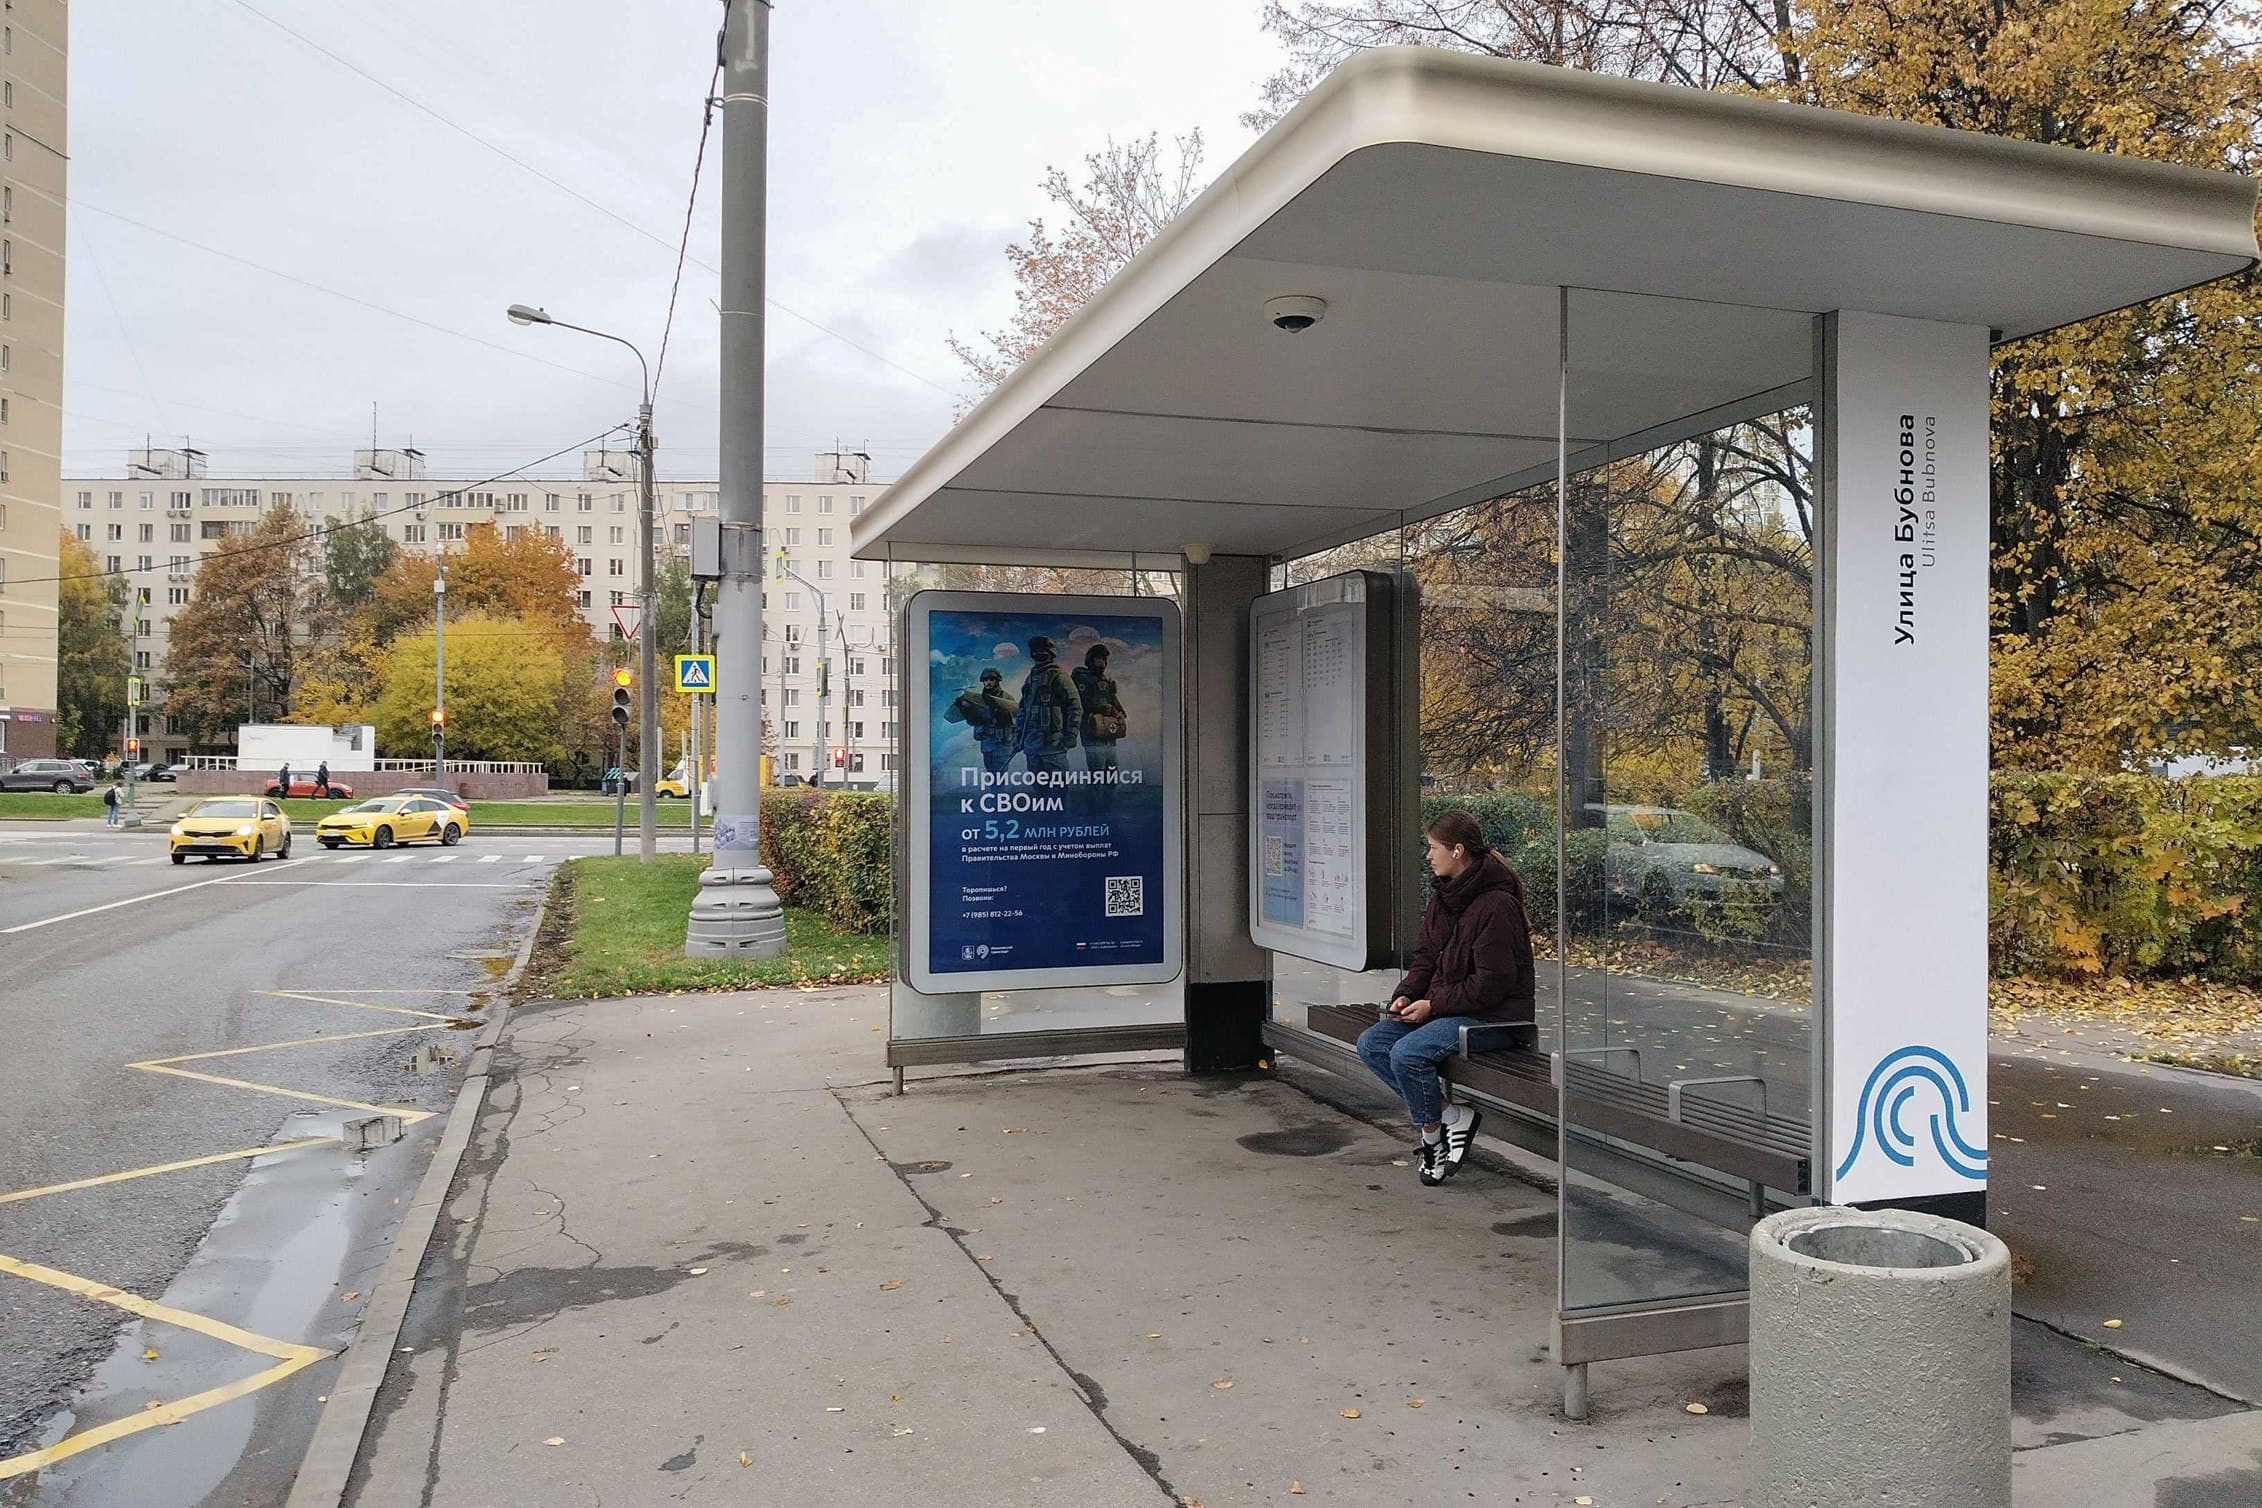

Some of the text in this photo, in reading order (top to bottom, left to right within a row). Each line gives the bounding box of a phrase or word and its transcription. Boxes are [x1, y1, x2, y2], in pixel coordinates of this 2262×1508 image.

[1921, 415, 1936, 568] Ulitsa Bubnova
[1894, 414, 1919, 645] Улица Бубнова
[961, 766, 1143, 790] Присоединяйся
[961, 793, 1064, 813] к СВОим
[961, 819, 1110, 843] от 5,2 МЛН РУБЛЕЙ
[961, 854, 1018, 863] Правительства
[1058, 851, 1106, 860] Минобороны
[968, 846, 998, 855] расчете
[1010, 843, 1038, 852] первый
[962, 885, 1008, 894] Торопишься?
